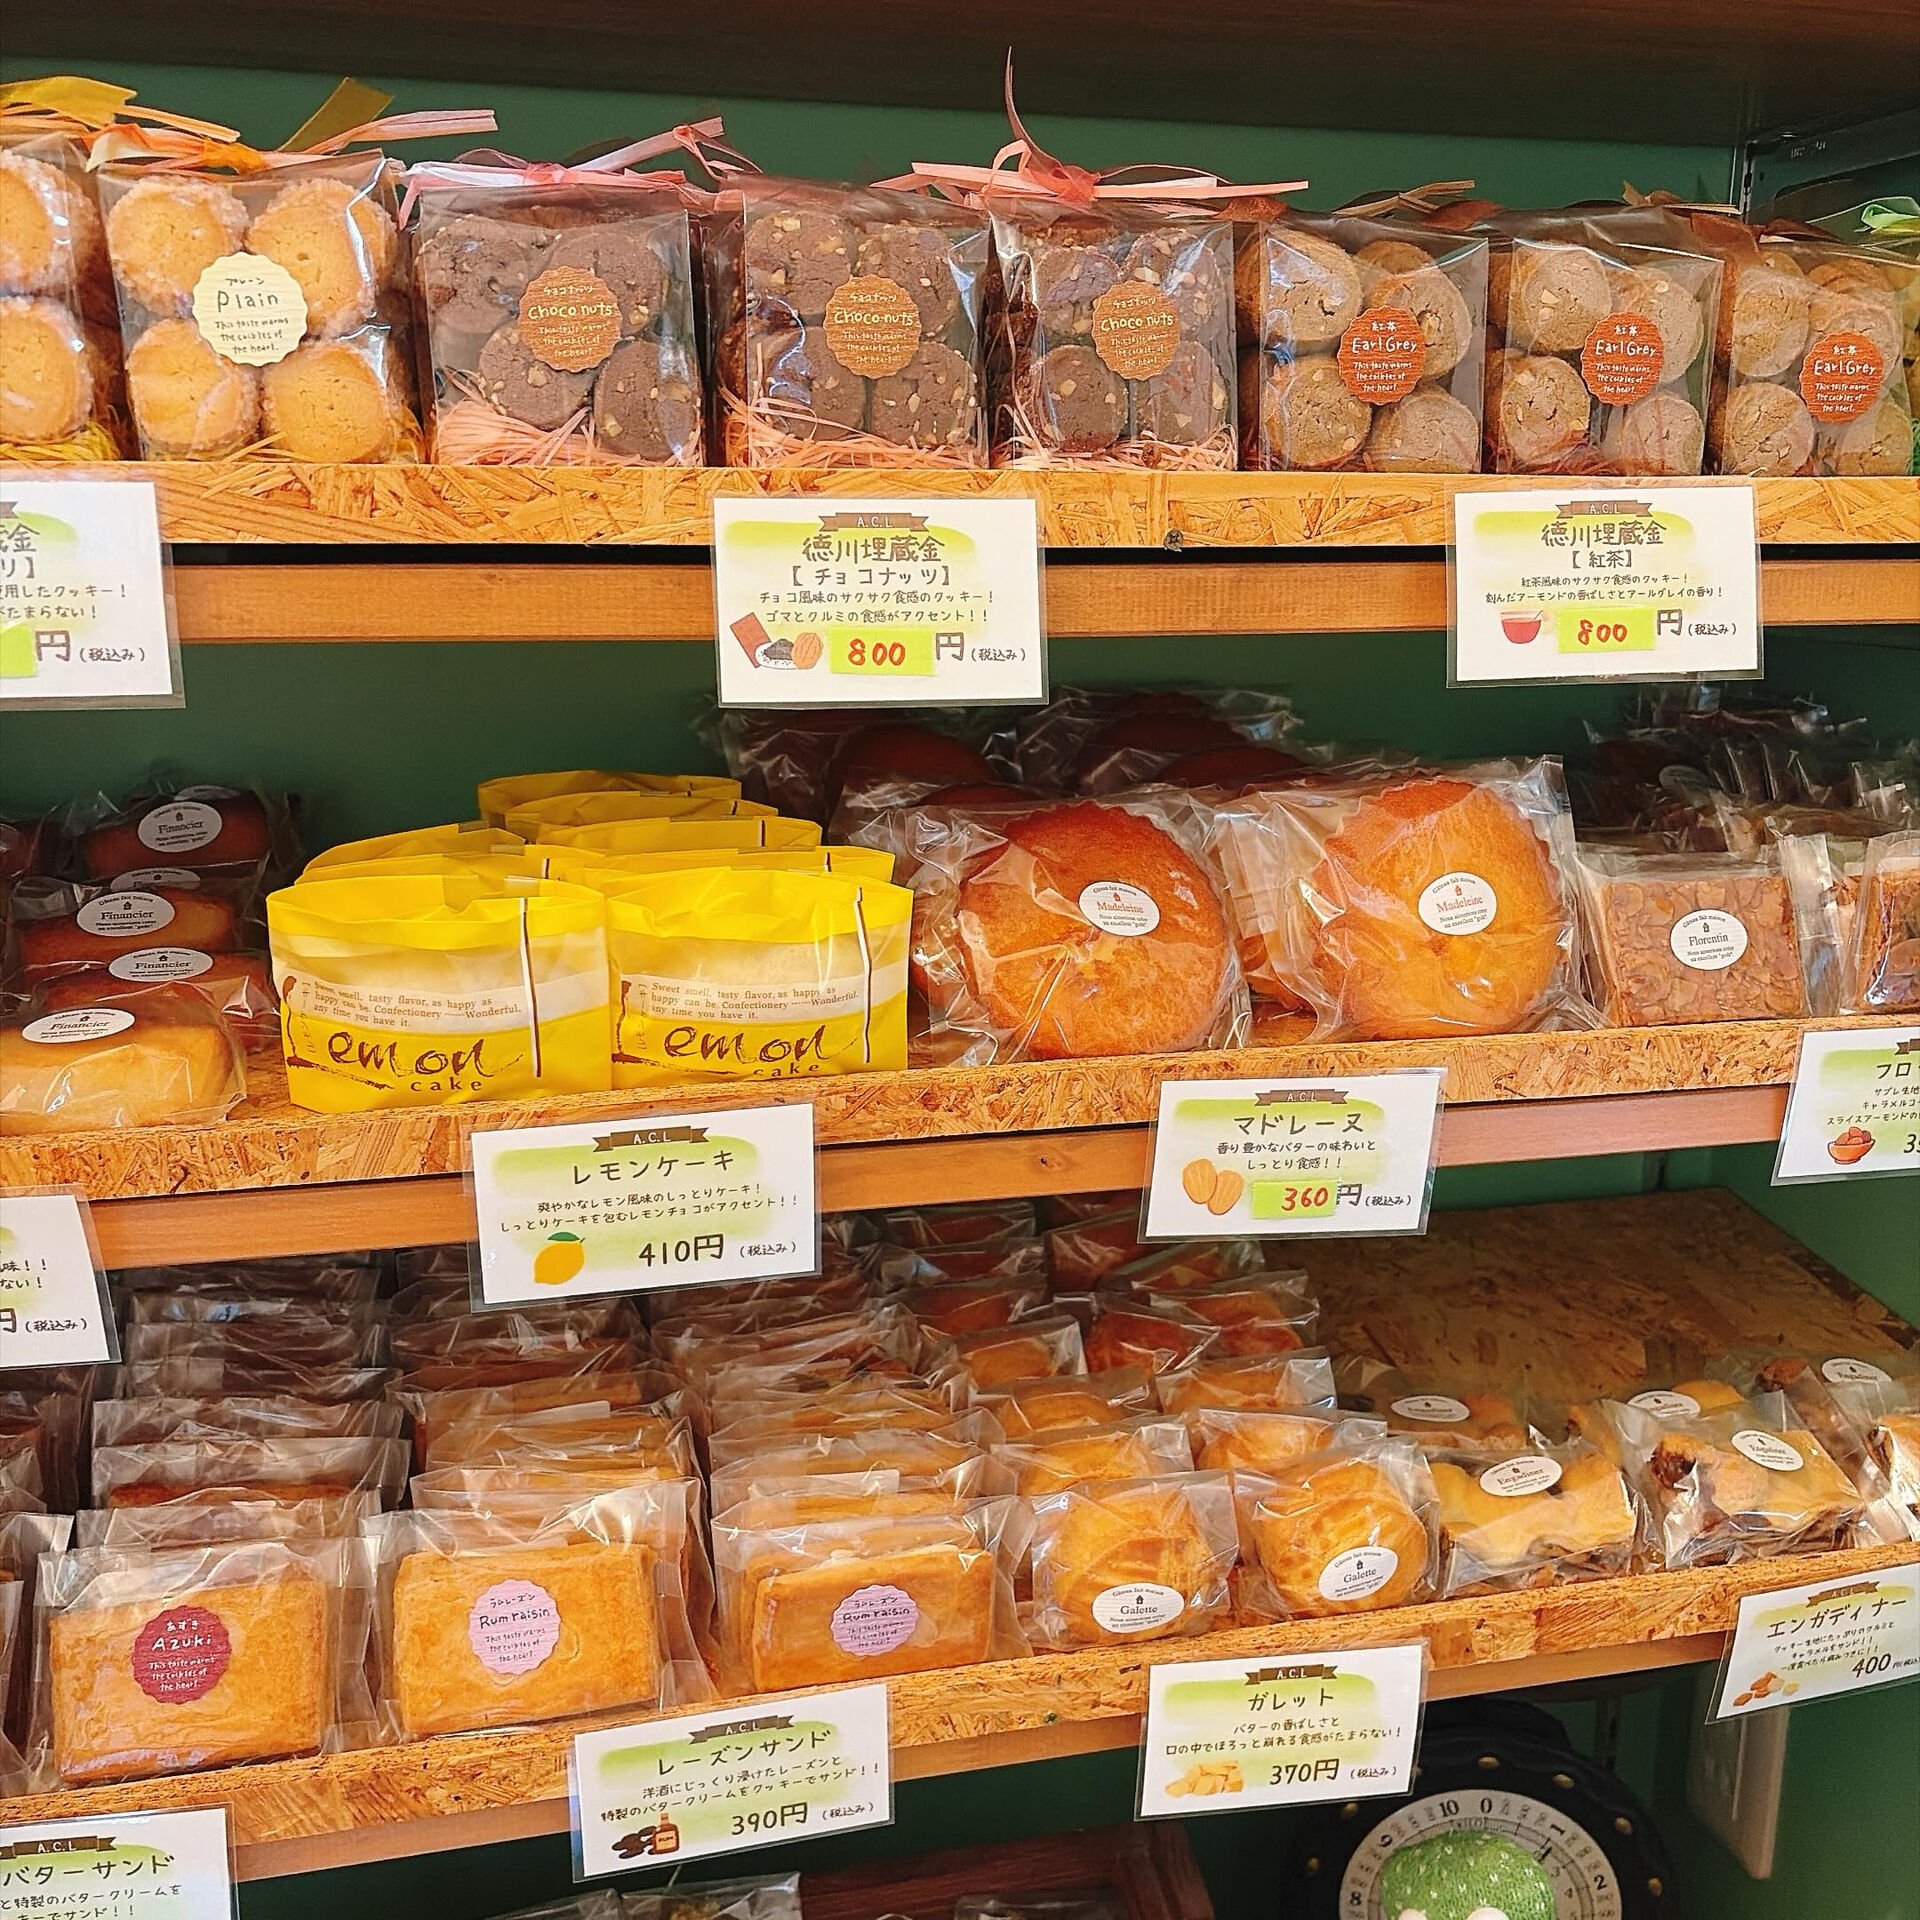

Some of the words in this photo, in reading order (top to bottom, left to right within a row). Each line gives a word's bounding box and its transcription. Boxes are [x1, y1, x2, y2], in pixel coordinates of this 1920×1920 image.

[217, 290, 278, 313] Plain
[528, 305, 576, 319] Choco
[581, 302, 613, 316] nuts
[834, 310, 880, 324] Choco
[884, 312, 913, 326] nuts
[1101, 317, 1142, 332] Choco
[1146, 312, 1173, 326] nuts
[1352, 337, 1381, 354] Earl
[1385, 336, 1417, 352] Grey
[1595, 340, 1624, 356] Earl
[1627, 341, 1656, 357] Grey
[1814, 360, 1842, 376] Earl
[1845, 360, 1877, 376] Grey
[1589, 502, 1621, 515] A.C.L
[857, 516, 893, 528] A.C.L
[0, 523, 40, 552] 金
[1541, 520, 1667, 548] 徳川埋蔵金
[802, 534, 945, 564] 徳川埋蔵金
[1572, 549, 1633, 569] 【紅茶】
[792, 565, 950, 586] 【チョコナッツ】
[1521, 573, 1688, 588] 紅茶風味のサクサク食感のクッキー！
[0, 584, 126, 599] 用したクッキー！
[759, 590, 994, 604] チョコ風味のサクサク食感のクッキー！
[1486, 586, 1723, 604] 刻んだアーモンドの香ばしさとアールグレイの香り！
[0, 605, 97, 619] たまらない！
[766, 609, 988, 623] ゴマとクルミの食感がアクセント！！
[1577, 619, 1628, 646] 800
[1657, 608, 1683, 636] 円
[1688, 622, 1737, 637] （税込み）
[35, 630, 71, 662] 円
[79, 648, 145, 662] （税込み）
[848, 638, 906, 667] 800
[935, 632, 965, 661] 円
[971, 648, 1026, 661] （税込み）
[158, 821, 204, 834] Financier
[1097, 901, 1144, 913] Madeleine
[1436, 896, 1483, 913] Madeleine
[101, 910, 154, 920] Financier
[1688, 933, 1729, 946] Florentin
[135, 961, 191, 969] Financier
[652, 983, 680, 994] Sweet
[717, 990, 740, 1000] tasty
[793, 989, 820, 999] happy
[826, 986, 836, 995] as
[369, 993, 393, 1004] tasty
[432, 999, 442, 1007] as
[447, 999, 476, 1011] happy
[482, 997, 492, 1007] as
[684, 999, 700, 1008] can
[722, 1001, 788, 1010] Confectionery
[374, 1005, 442, 1019] Confectionery
[672, 1007, 693, 1017] time
[698, 1011, 715, 1020] you
[720, 1011, 743, 1020] have
[748, 1011, 758, 1020] it.
[50, 1021, 110, 1030] Financier
[374, 1015, 396, 1026] have
[400, 1017, 412, 1027] it.
[753, 1063, 819, 1078] cake
[1876, 1062, 1920, 1079] フロ
[410, 1077, 482, 1091] cake
[1234, 1112, 1365, 1136] マドレーヌ
[1826, 1111, 1920, 1125] スライスアーモンドの
[632, 1130, 671, 1145] A.C.L
[1216, 1140, 1376, 1155] 香り豊かなバターの味わいと
[573, 1150, 734, 1186] レモンケーキ
[1247, 1157, 1342, 1170] しっとり食感！！
[537, 1183, 761, 1213] 爽やかなレモン風味のしっとりケーキ！
[1281, 1186, 1329, 1212] 360
[1337, 1183, 1363, 1207] 円
[1366, 1195, 1413, 1207] （税込み）
[501, 1195, 798, 1232] しっとりケーキを包むレモンチョコがアクセント！！
[638, 1233, 725, 1267] 410円
[739, 1241, 797, 1258] （税込み）
[0, 1258, 47, 1273] 味！！
[25, 1318, 88, 1333] （税込み）
[1344, 1568, 1377, 1583] Galette
[480, 1614, 508, 1629] Rum
[512, 1608, 550, 1621] raisin
[843, 1612, 870, 1624] Rum
[873, 1608, 910, 1618] raisin
[1120, 1605, 1158, 1615] Galette
[1766, 1598, 1907, 1639] エンガディナー
[167, 1618, 199, 1632] あずき
[152, 1634, 211, 1651] Azuki
[1276, 1667, 1308, 1679] A.C.L
[1852, 1652, 1892, 1679] 400
[1248, 1688, 1335, 1712] ガレット
[1233, 1716, 1340, 1734] バターの香ばしさと
[1166, 1726, 1401, 1755] 口の中でほろっと崩れる食感がたまらない！
[658, 1729, 832, 1776] レーズンサンド
[642, 1756, 842, 1799] 洋酒にじっくり浸けたレーズンと
[1269, 1758, 1339, 1786] 370円
[1350, 1766, 1398, 1780] （税込み）
[601, 1763, 880, 1823] 特製のバタークリームをクッキーでサンド！！
[1438, 1799, 1460, 1817] 10
[1480, 1797, 1493, 1814] 0
[731, 1802, 809, 1836] 390円
[822, 1802, 874, 1821] （税込み）
[37, 1840, 77, 1853] A.C.L
[3, 1854, 175, 1887] バターサンド
[1593, 1874, 1607, 1891] 2
[1, 1884, 182, 1910] と特製のバタークリームを
